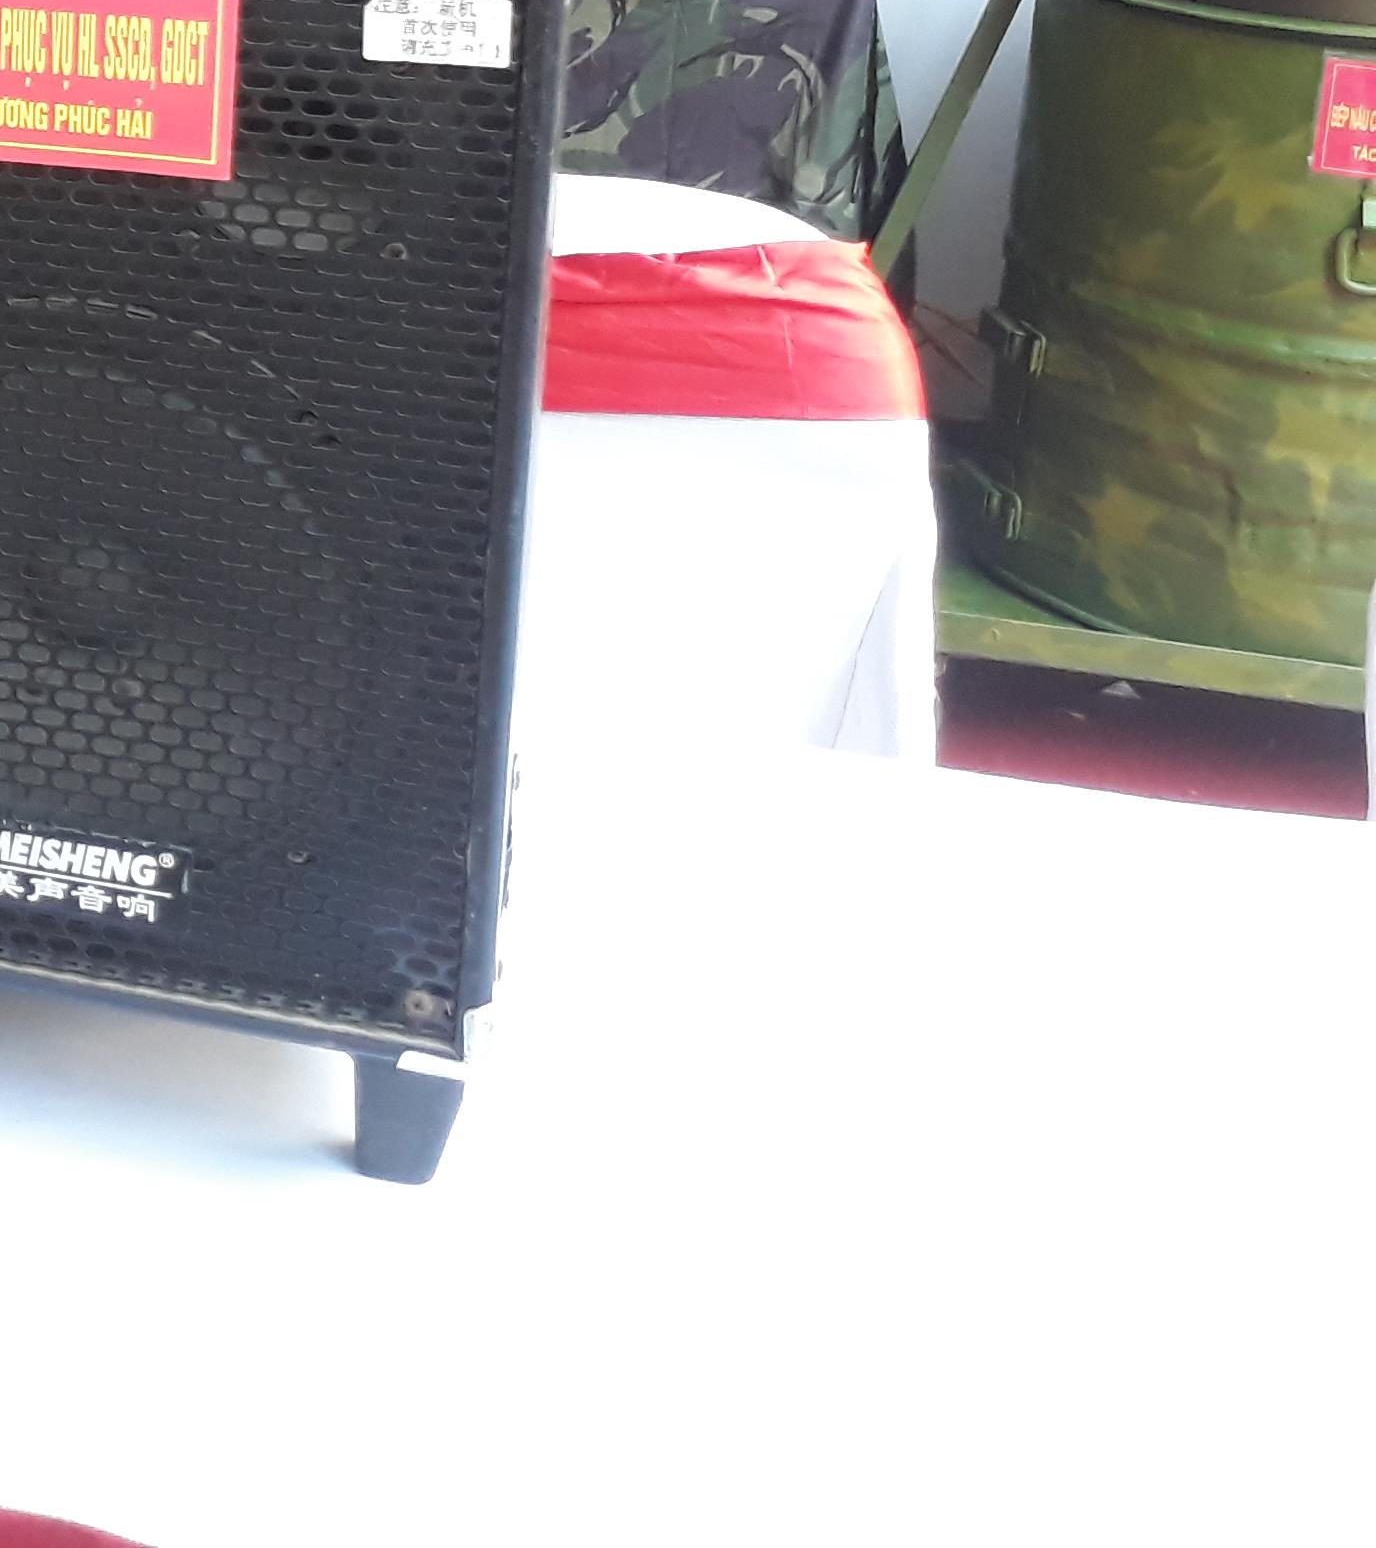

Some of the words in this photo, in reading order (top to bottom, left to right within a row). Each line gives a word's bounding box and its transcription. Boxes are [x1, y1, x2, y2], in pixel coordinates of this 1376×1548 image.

[0, 6, 47, 89] PHỤC
[51, 10, 76, 91] VỤ
[77, 12, 100, 79] HL
[160, 17, 210, 86] GDCT
[53, 100, 112, 136] PHÚC
[115, 97, 154, 140] HẢI
